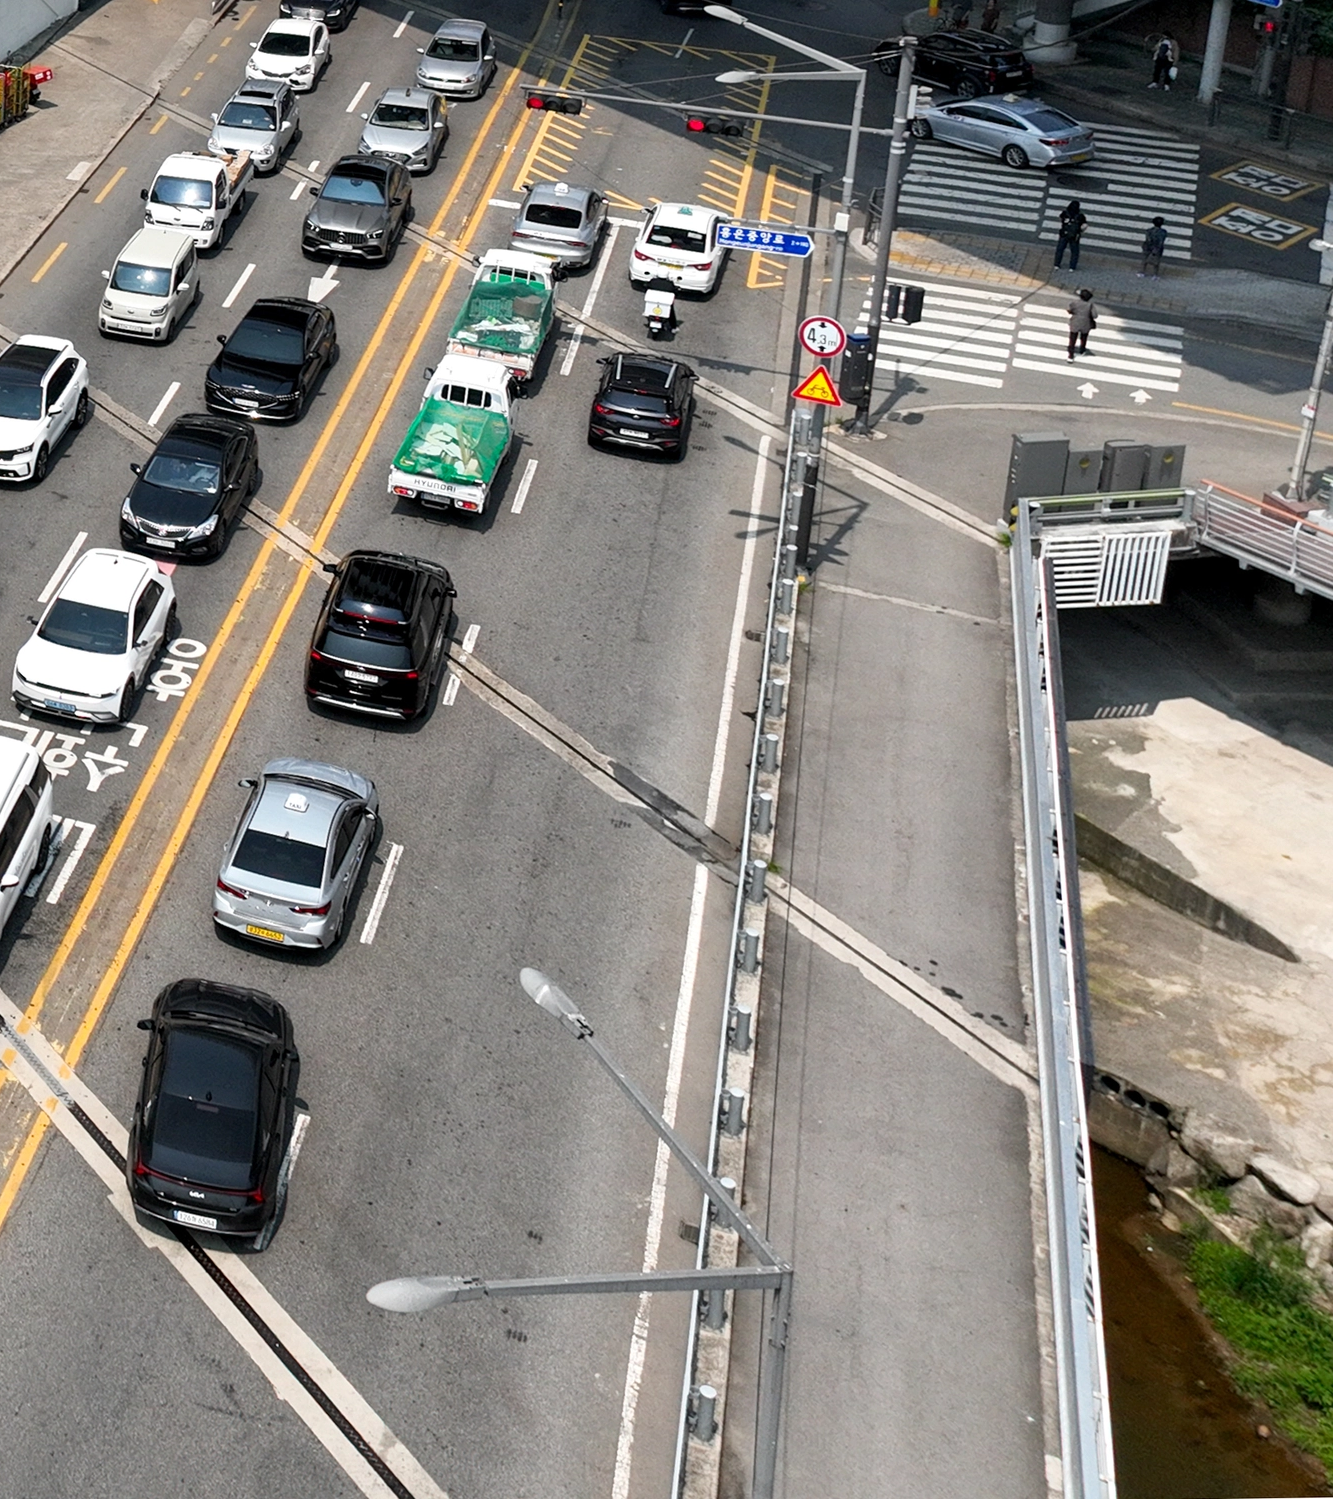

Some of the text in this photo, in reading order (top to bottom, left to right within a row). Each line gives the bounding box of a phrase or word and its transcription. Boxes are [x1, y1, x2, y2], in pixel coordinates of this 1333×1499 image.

[719, 226, 785, 245] 홍은중앙로
[413, 477, 457, 493] HYUNDAI
[289, 802, 302, 810] TAXI
